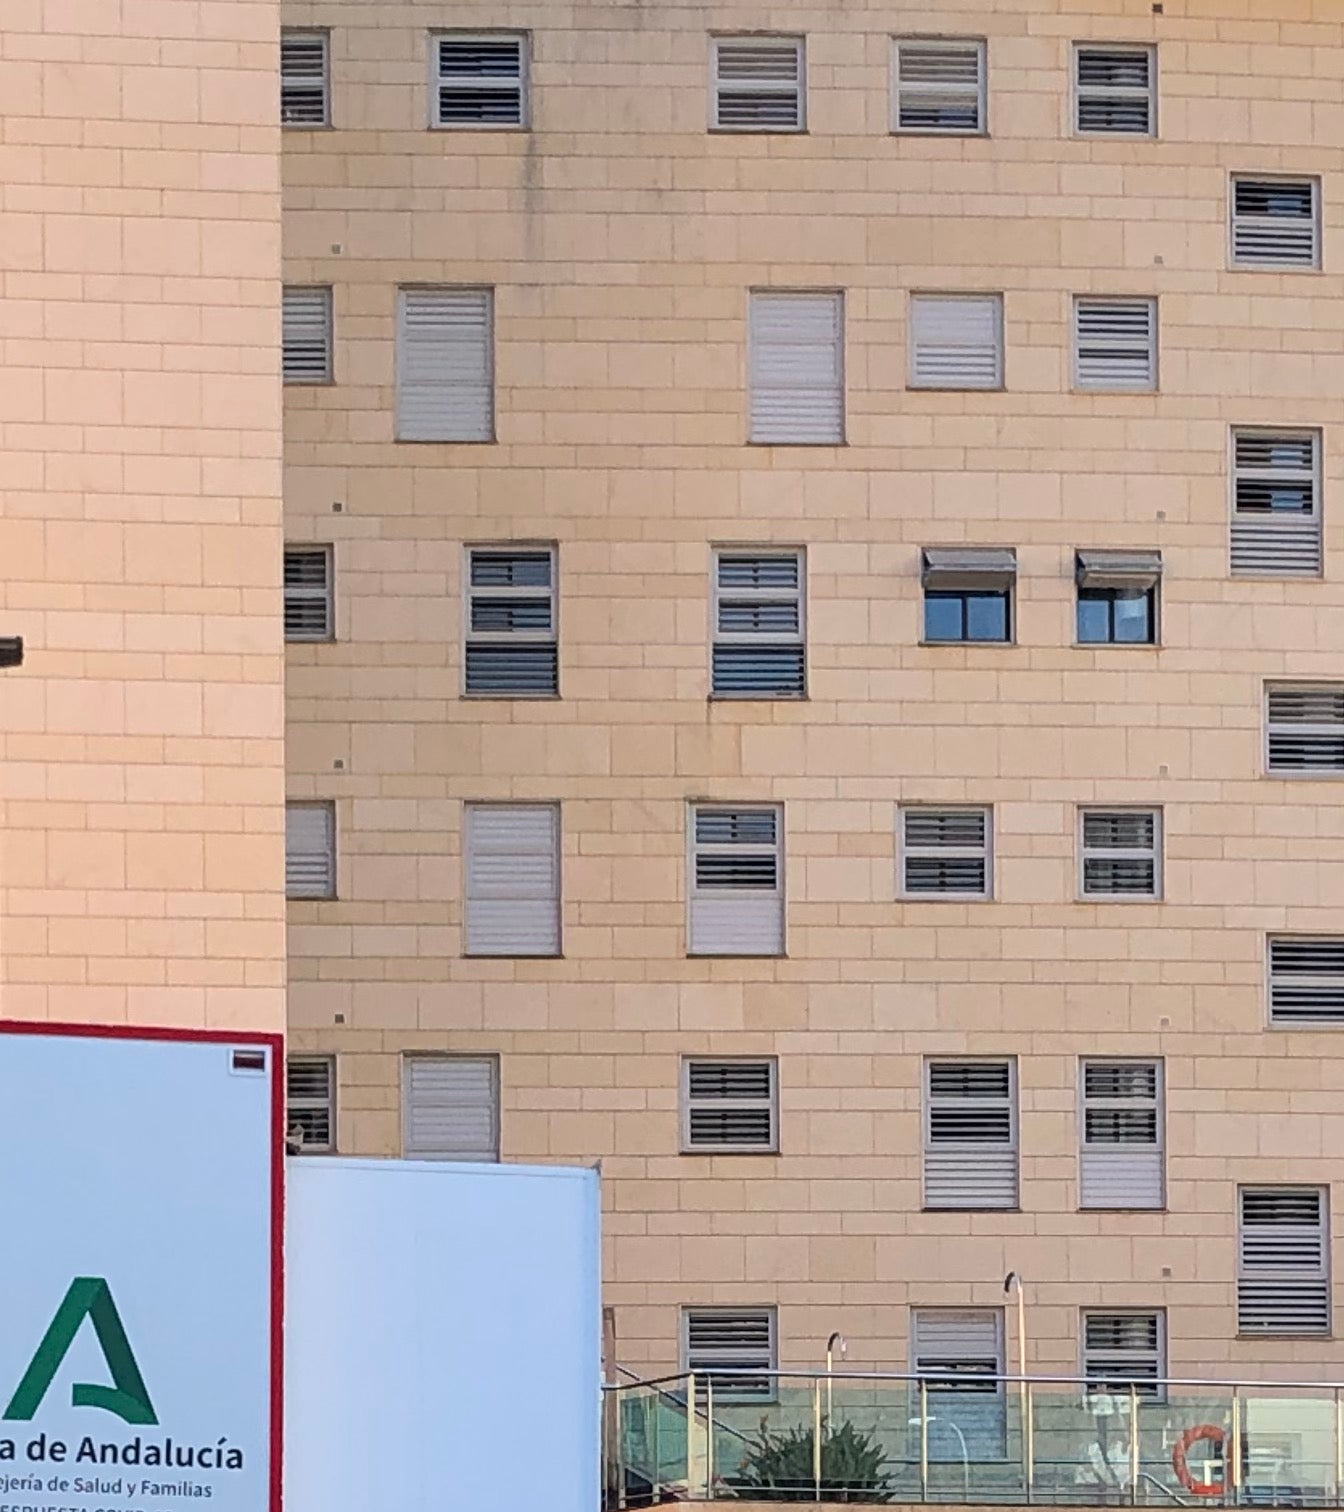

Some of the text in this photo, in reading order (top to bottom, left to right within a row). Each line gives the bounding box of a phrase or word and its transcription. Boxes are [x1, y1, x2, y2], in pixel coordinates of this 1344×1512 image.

[26, 1433, 67, 1463] de
[76, 1436, 244, 1470] Andalucía
[47, 1476, 70, 1492] de
[73, 1477, 122, 1495] Salud
[126, 1482, 137, 1497] y
[141, 1480, 212, 1498] Familias
